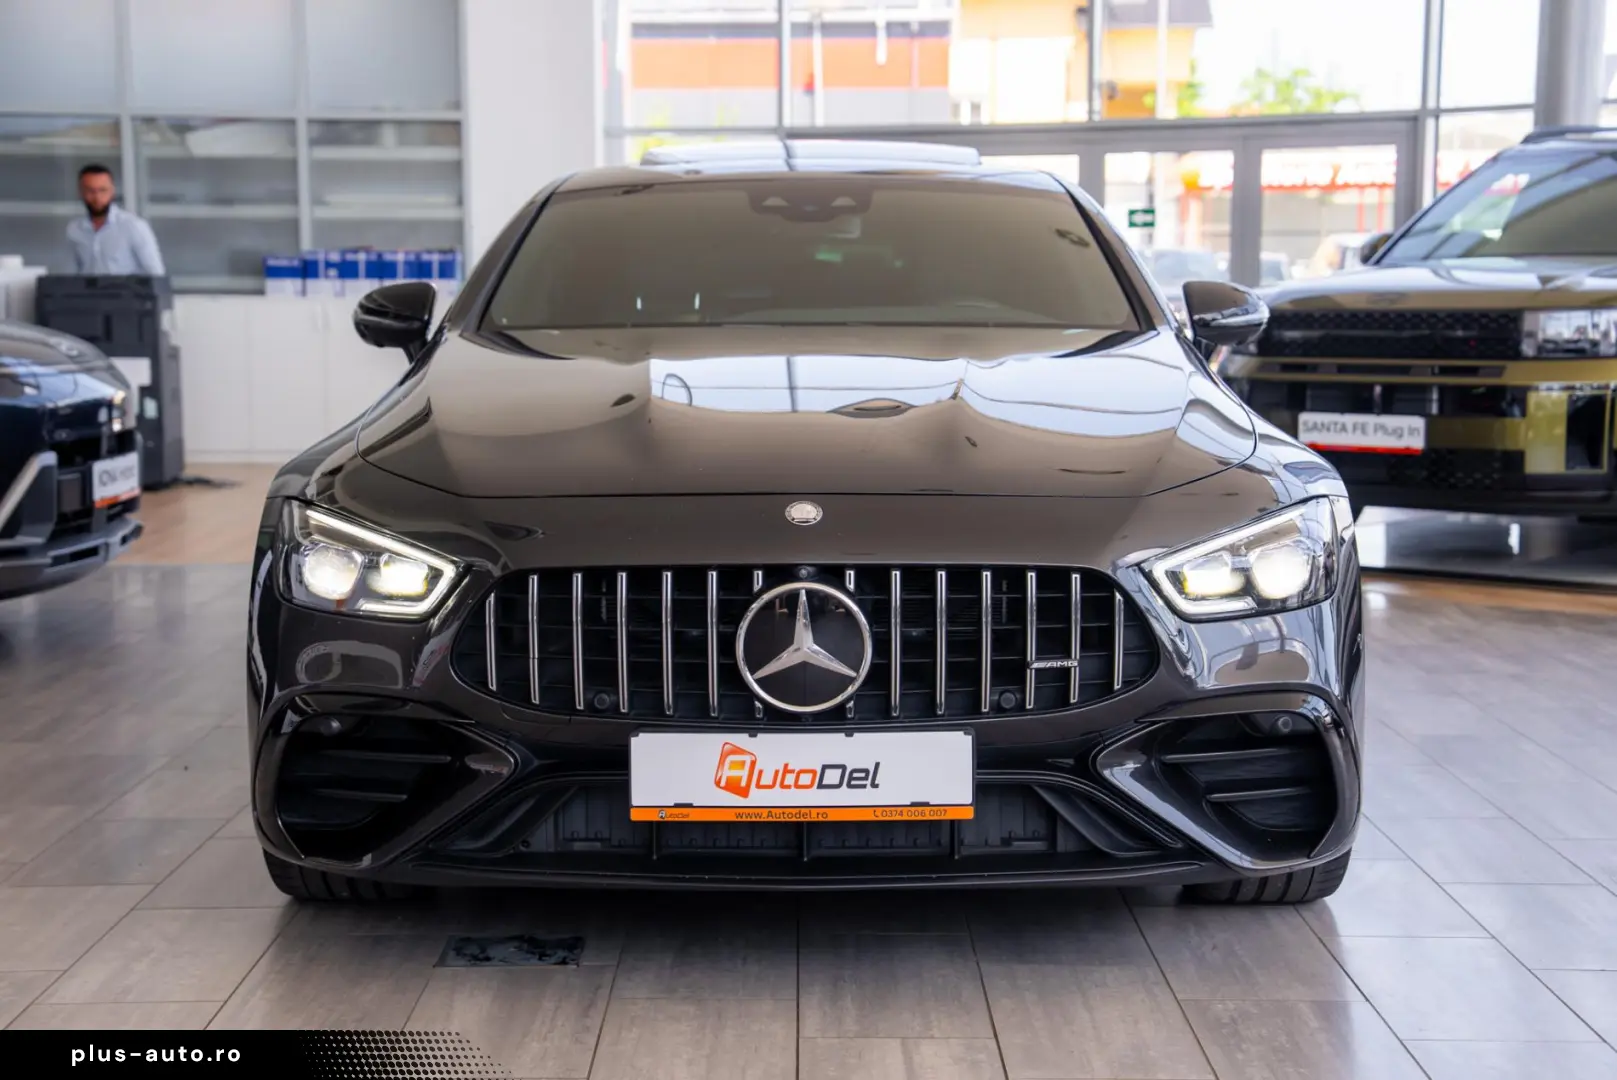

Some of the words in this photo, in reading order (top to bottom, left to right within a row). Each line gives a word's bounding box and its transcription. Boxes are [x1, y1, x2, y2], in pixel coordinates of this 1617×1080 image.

[1302, 420, 1347, 434] SANTA
[1352, 421, 1369, 436] FE
[1373, 422, 1404, 440] Plug
[715, 744, 880, 796] AutoDel
[735, 810, 828, 819] www.Autodel.ro
[929, 809, 947, 817] 007
